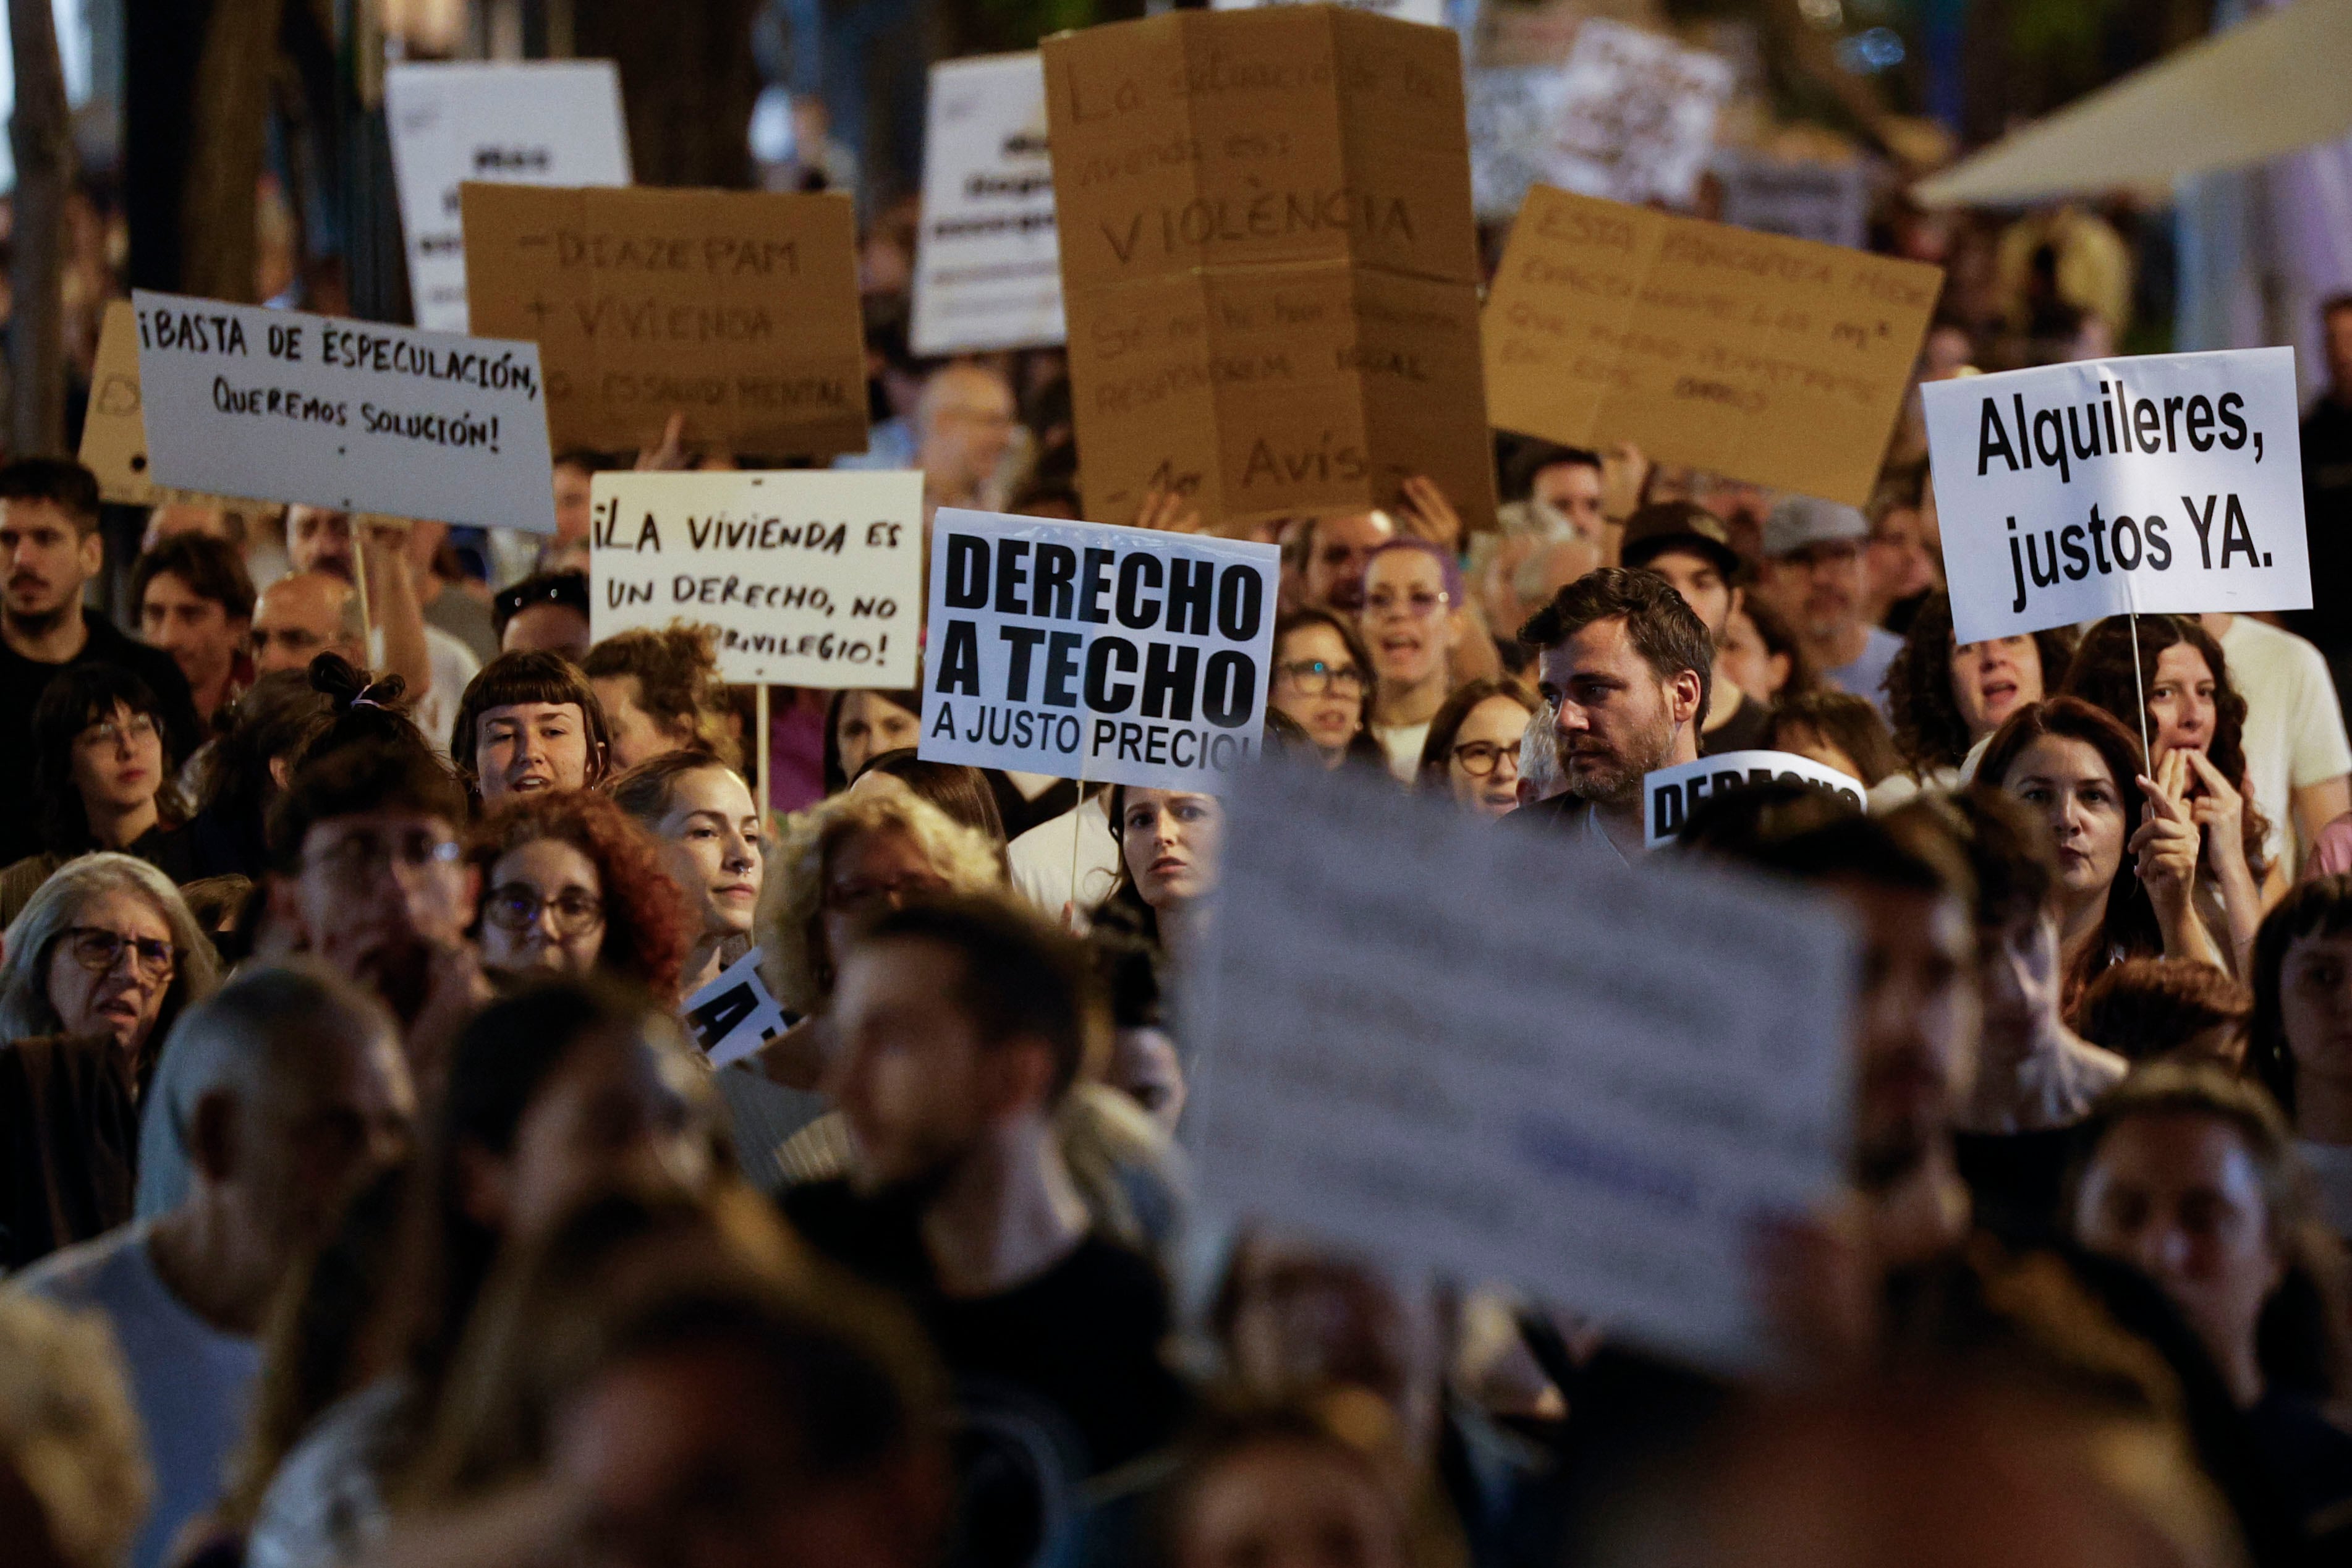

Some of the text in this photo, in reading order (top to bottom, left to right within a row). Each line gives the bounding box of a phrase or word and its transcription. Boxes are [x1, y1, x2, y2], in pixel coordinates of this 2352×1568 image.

[1065, 62, 1144, 124] La
[1100, 174, 1417, 265] VIOLÈNCIA
[138, 310, 537, 399] ¡BASTA DE ESPECULACIÓN,
[213, 376, 500, 452] QUEREMOS SOLUCIÓN!
[1977, 380, 2263, 483] Alquileres,
[594, 498, 902, 556] ¡LA VIVIENDA ES
[2006, 493, 2272, 614] justos YA.
[607, 575, 897, 619] UN DERECHO, NO
[945, 533, 1263, 642] DERECHO
[723, 628, 888, 666] RIVILEGIO!
[935, 619, 1255, 729] A TECHO
[931, 701, 956, 740] A
[966, 705, 1080, 754] JUSTO
